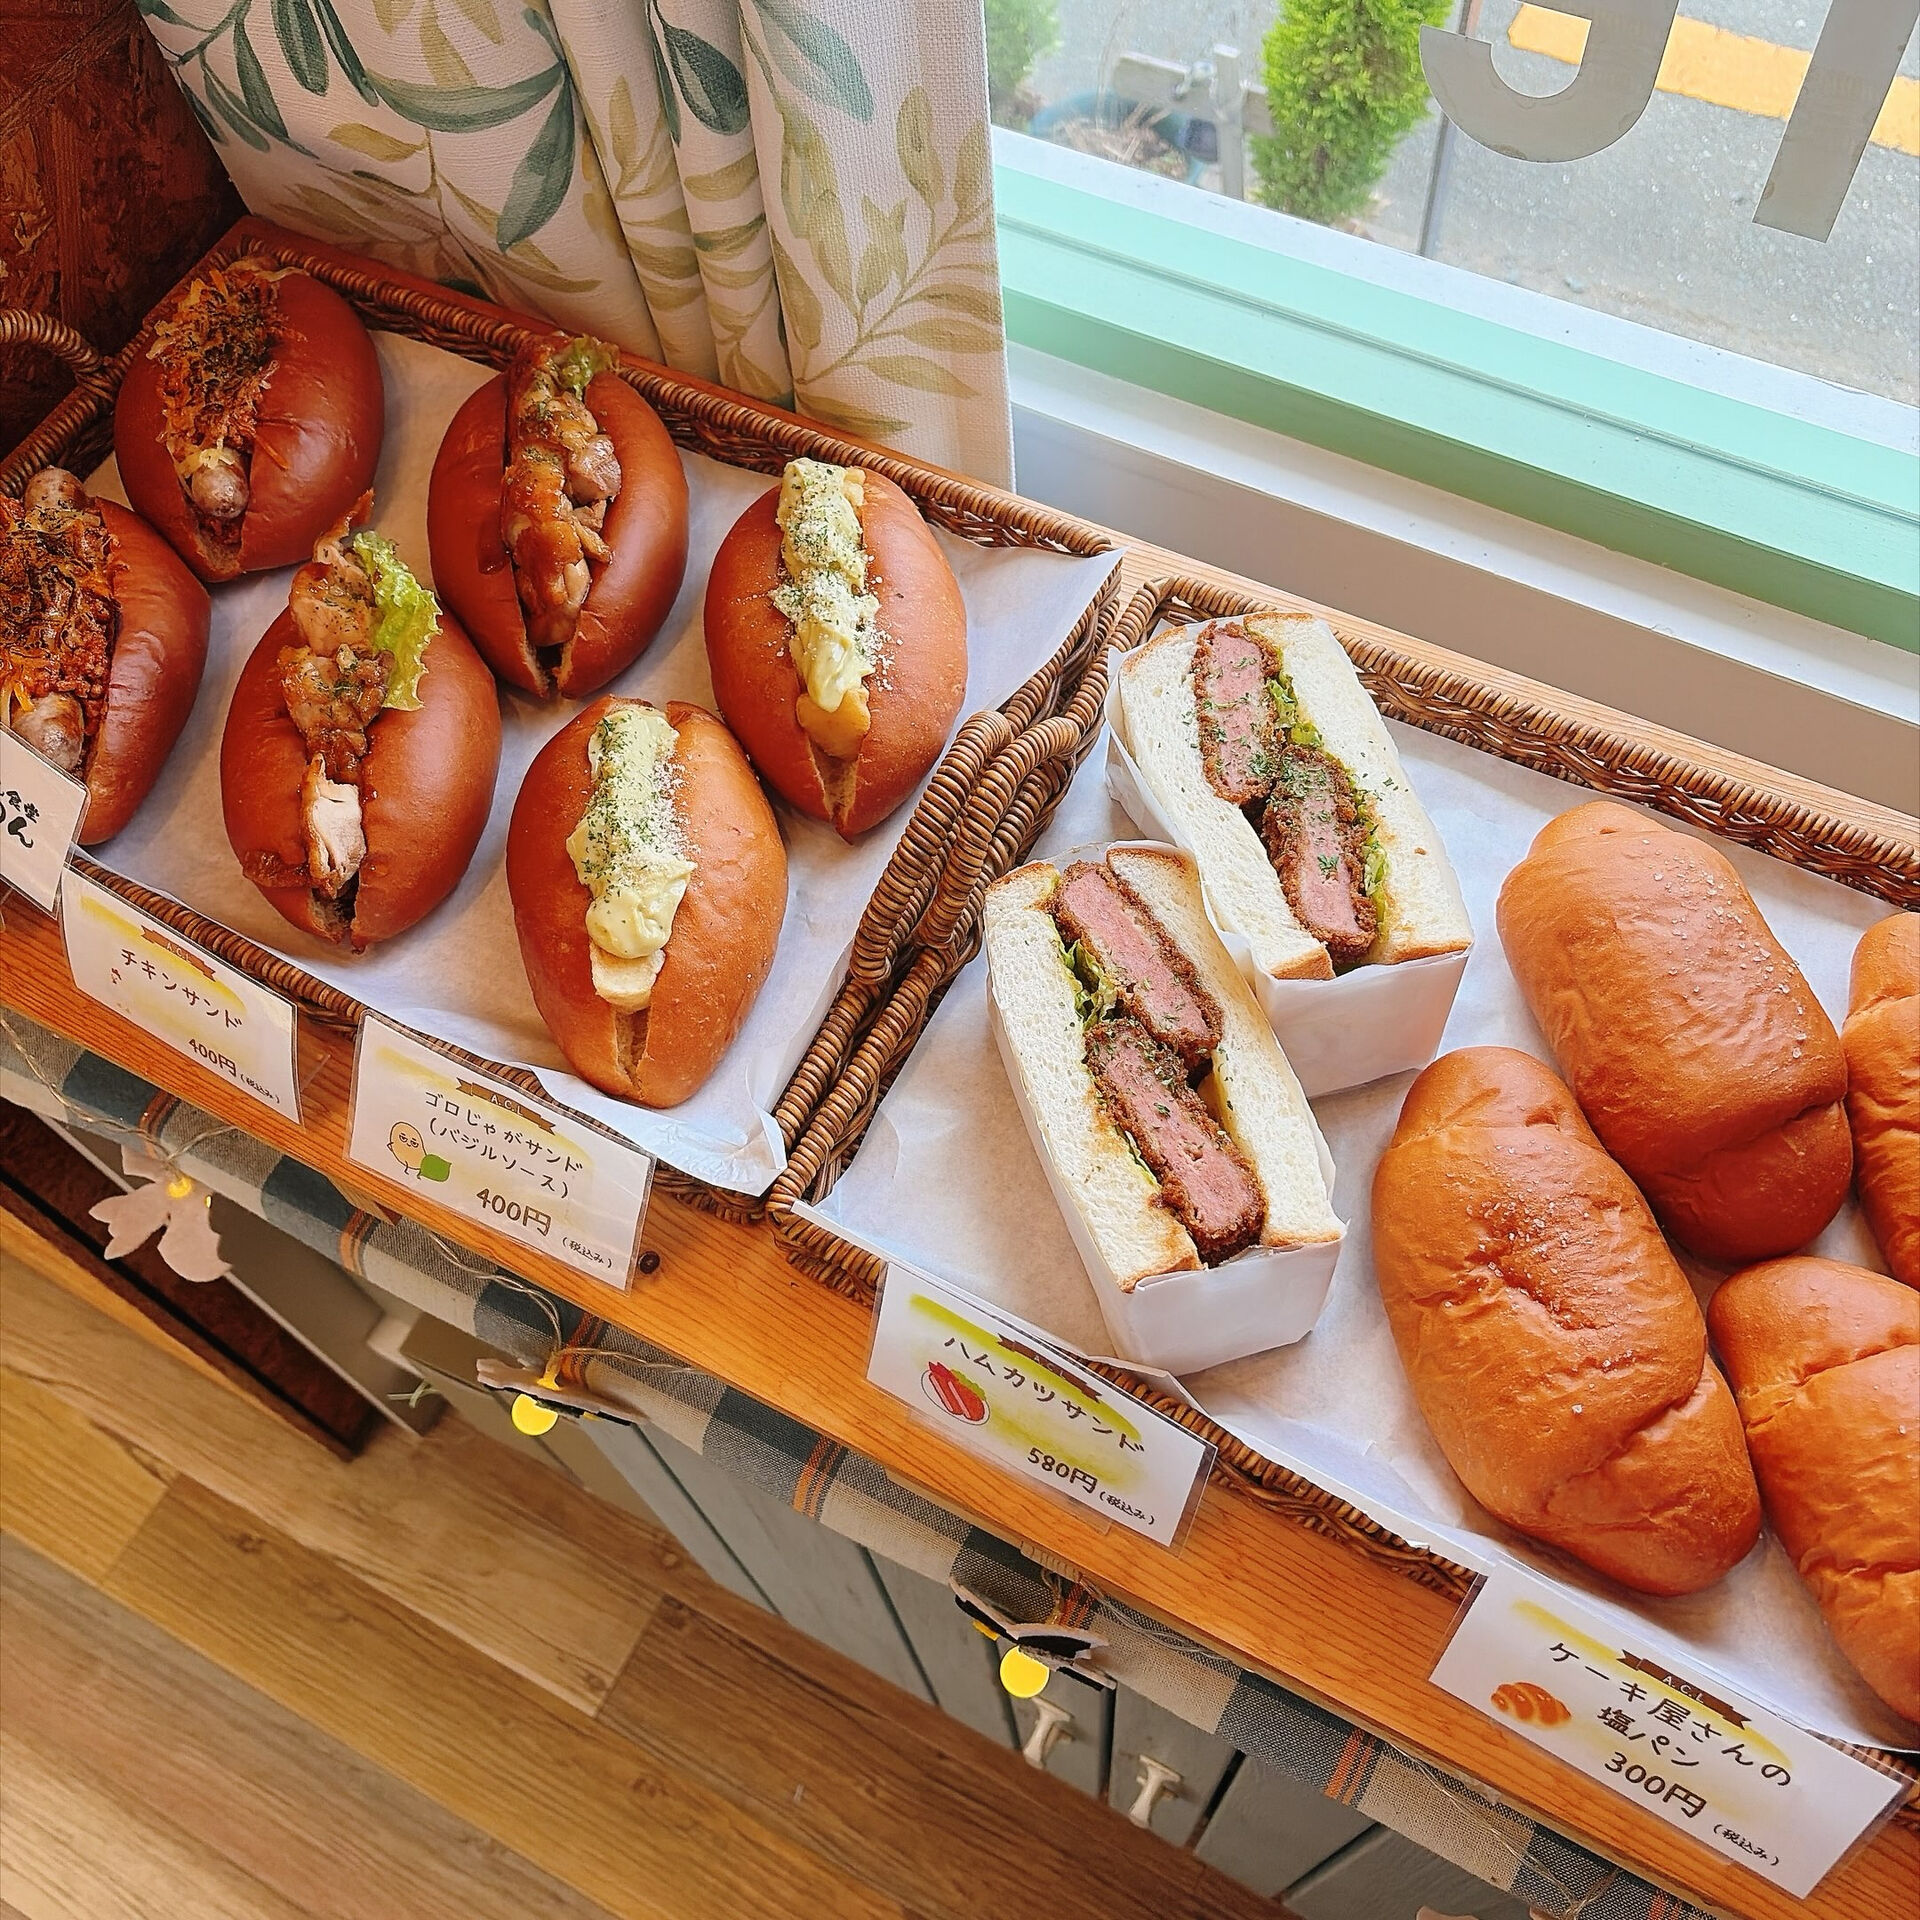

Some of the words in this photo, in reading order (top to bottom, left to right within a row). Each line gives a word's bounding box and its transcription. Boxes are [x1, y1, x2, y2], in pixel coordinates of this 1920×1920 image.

[0, 790, 40, 824] 食堂
[121, 948, 243, 1029] チキンサンド
[188, 1038, 237, 1078] 400円
[425, 1090, 583, 1173] ゴロじゃがサンド
[429, 1117, 569, 1199] （バジルソース）
[476, 1187, 552, 1237] 400円
[562, 1235, 613, 1269] （税込み）
[944, 1337, 1145, 1453] ハムカツサンド
[1027, 1446, 1098, 1494] 580円
[1099, 1490, 1156, 1526] （税込み）
[1549, 1641, 1792, 1787] ケーキ屋さんの
[1597, 1705, 1700, 1768] 塩パン
[1604, 1750, 1708, 1819] 300円
[1712, 1823, 1780, 1867] （税込み）
